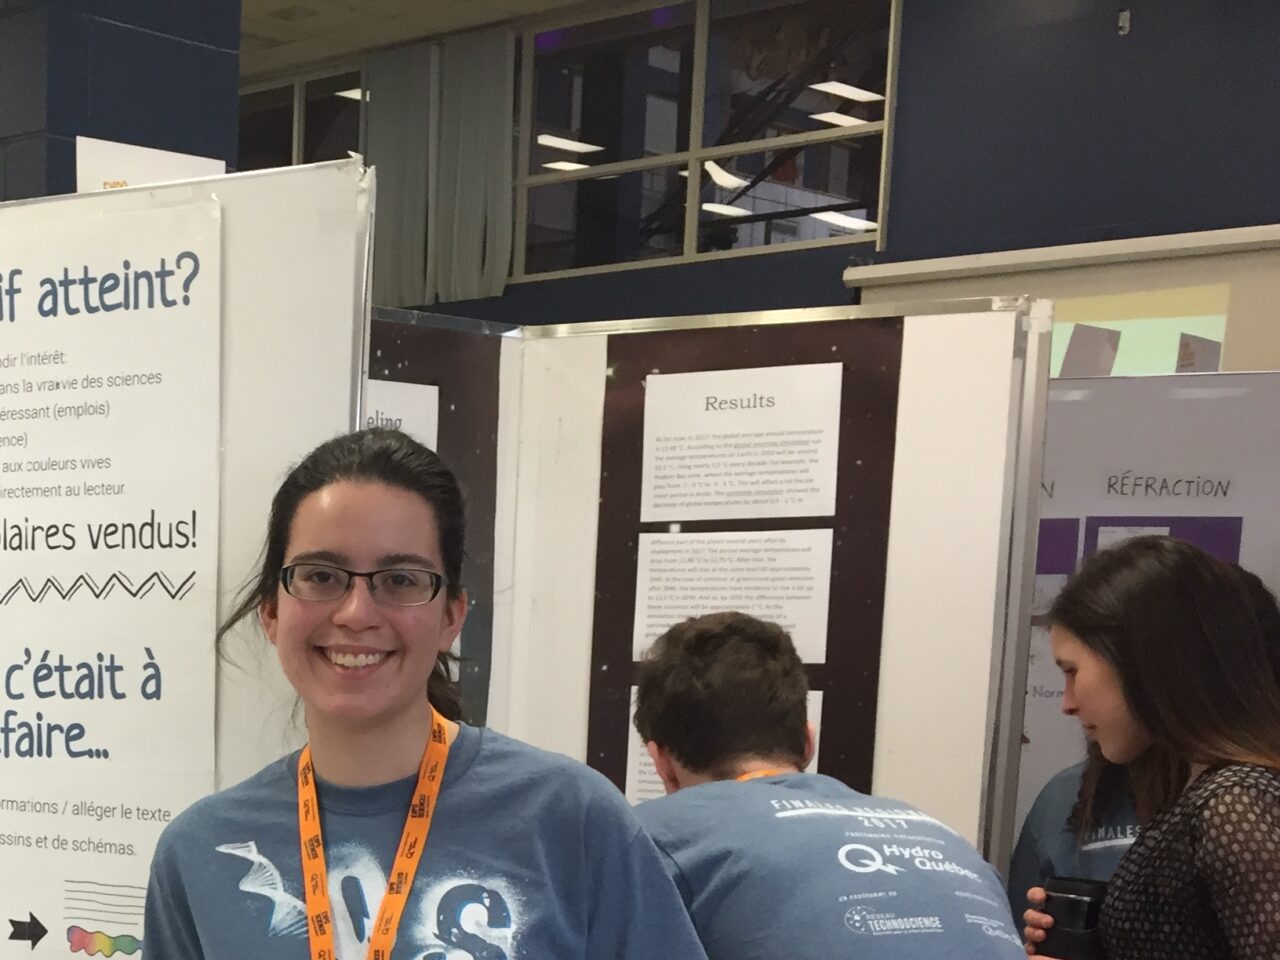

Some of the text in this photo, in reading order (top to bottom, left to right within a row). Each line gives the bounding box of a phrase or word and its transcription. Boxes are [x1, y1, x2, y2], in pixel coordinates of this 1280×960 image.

[38, 251, 200, 318] atteint?
[53, 400, 110, 420] (emplois)
[705, 393, 776, 412] Results
[2, 460, 23, 472] aux
[27, 457, 76, 472] couleurs
[80, 455, 111, 469] vives
[87, 509, 197, 549] vendus!
[5, 648, 127, 700] c'était
[140, 647, 162, 701] à
[858, 816, 908, 829] 2017
[883, 844, 943, 861] Hydro
[868, 917, 942, 931] TECHNOSCIENCE
